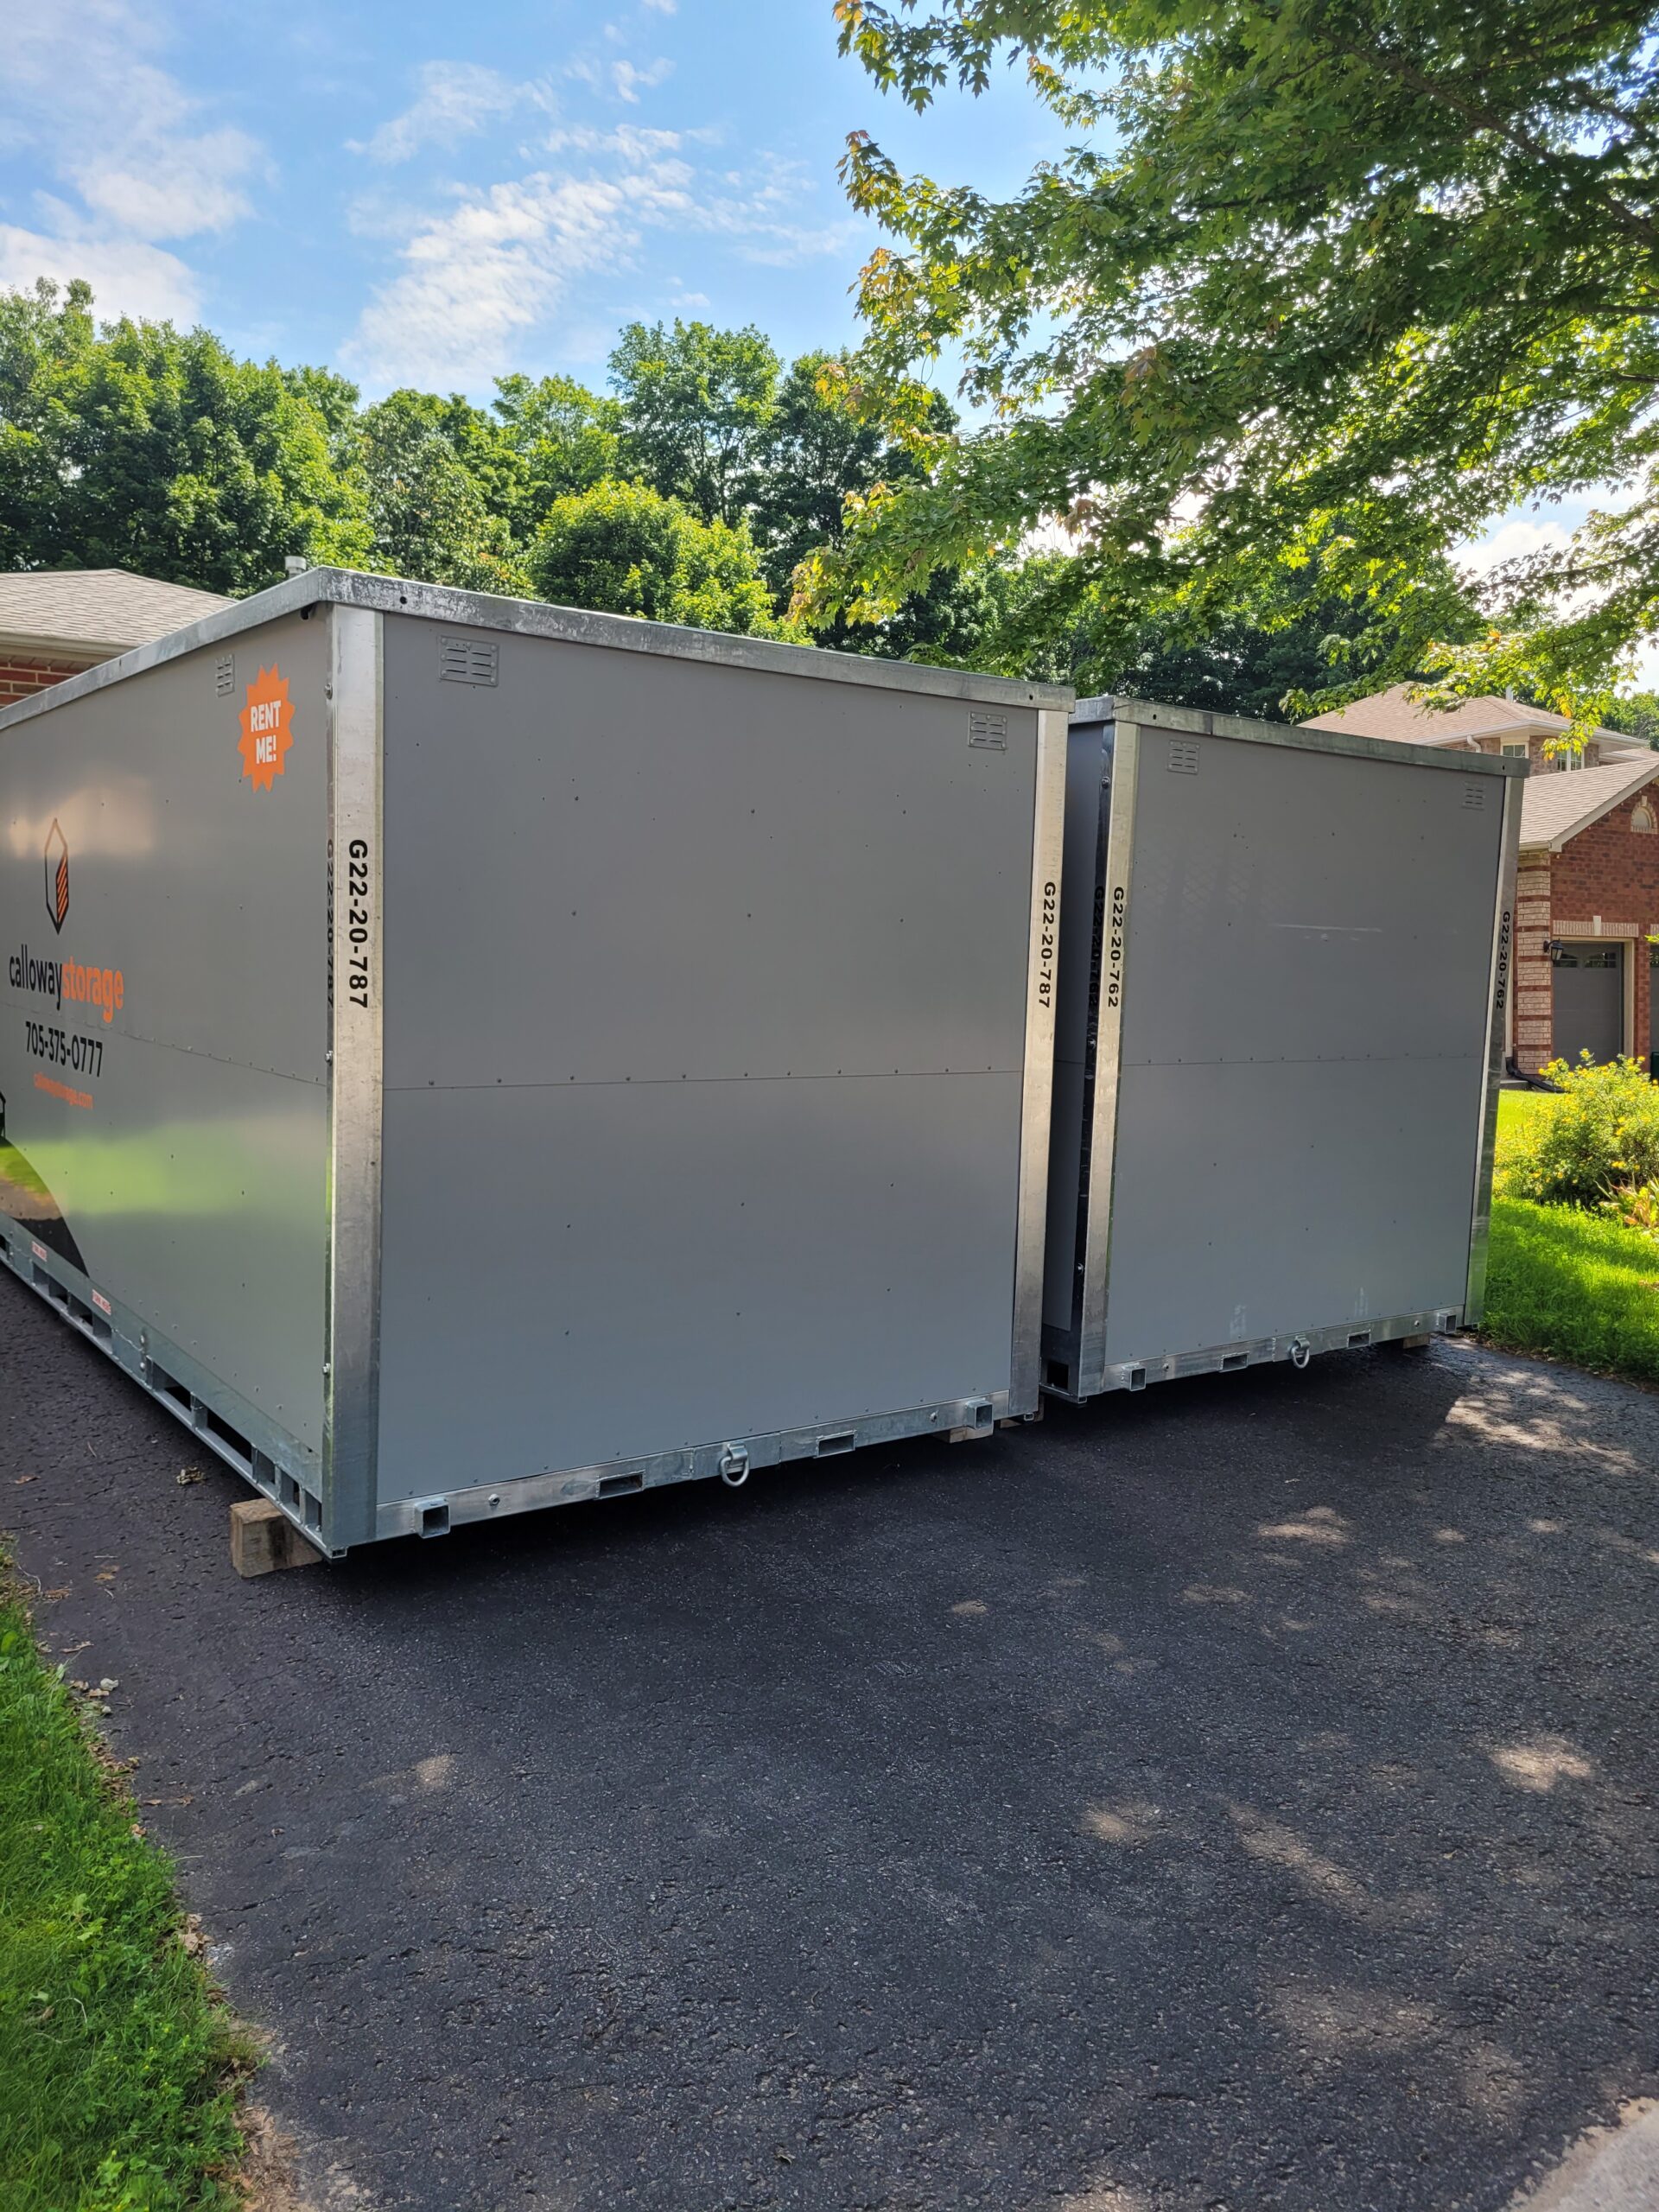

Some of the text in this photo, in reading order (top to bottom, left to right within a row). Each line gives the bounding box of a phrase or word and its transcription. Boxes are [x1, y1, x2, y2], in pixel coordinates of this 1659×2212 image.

[250, 700, 282, 733] RENT
[256, 734, 277, 765] ME!
[348, 839, 368, 1008] G22-20-787
[1039, 881, 1057, 1008] G22-20-787
[1108, 887, 1125, 1007] G22-20-762
[1496, 911, 1511, 1010] G22-20-762
[25, 1020, 103, 1077] 705-375-0777
